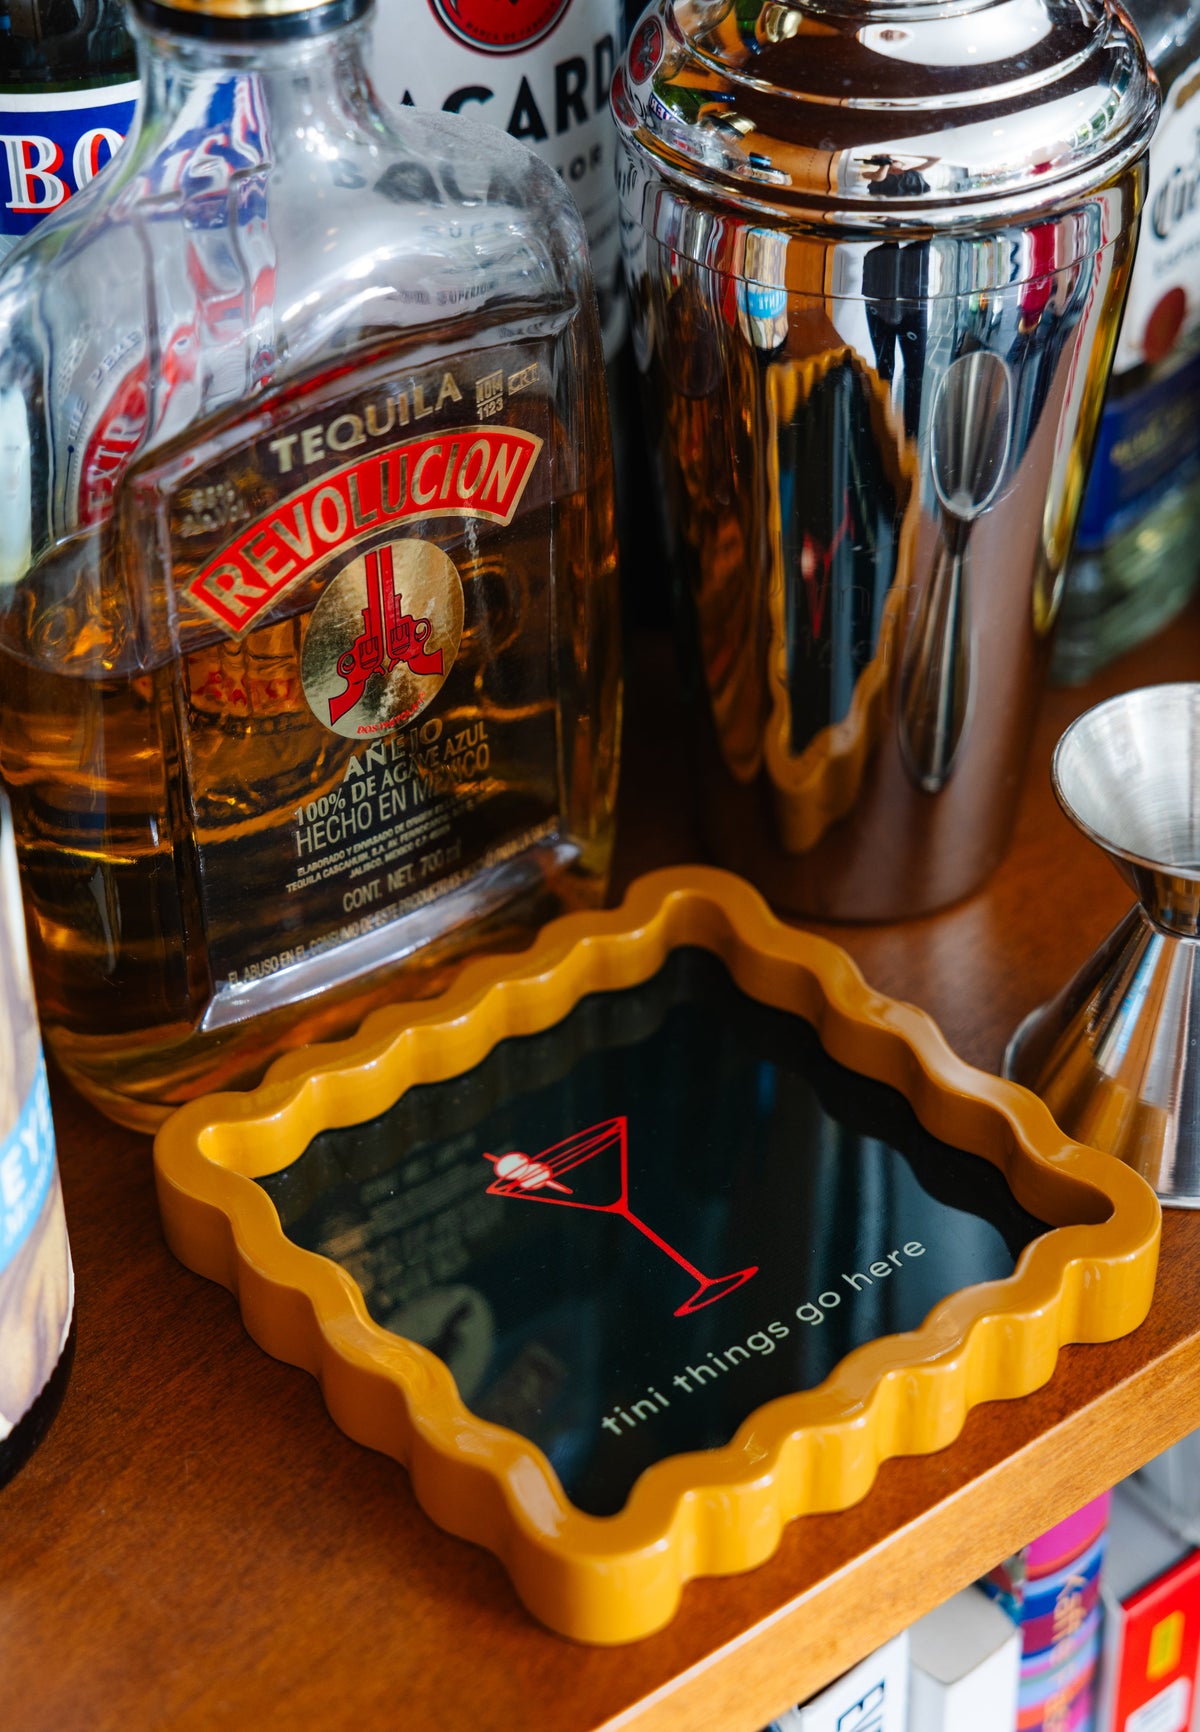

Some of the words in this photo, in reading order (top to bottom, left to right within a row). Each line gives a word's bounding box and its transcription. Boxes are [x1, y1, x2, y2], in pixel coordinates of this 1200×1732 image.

[475, 373, 504, 404] NOM
[475, 397, 504, 421] 1123
[269, 372, 463, 474] TEQUILA
[201, 438, 522, 617] REVOLUCION
[343, 718, 443, 783] AÑEJO
[356, 724, 378, 735] DOS
[294, 787, 347, 827] 100%
[351, 778, 377, 805] DE
[381, 746, 440, 791] AGAVE
[444, 720, 489, 760] AZUL
[294, 806, 373, 857] HECHO
[378, 787, 407, 822] EN
[286, 871, 322, 894] TEQUILA
[342, 878, 382, 913] CONT.
[387, 862, 416, 892] NET.
[243, 954, 279, 984] ABUSO
[601, 1386, 670, 1436] tini
[672, 1321, 790, 1393] things
[795, 1290, 841, 1326] go
[841, 1240, 926, 1292] here
